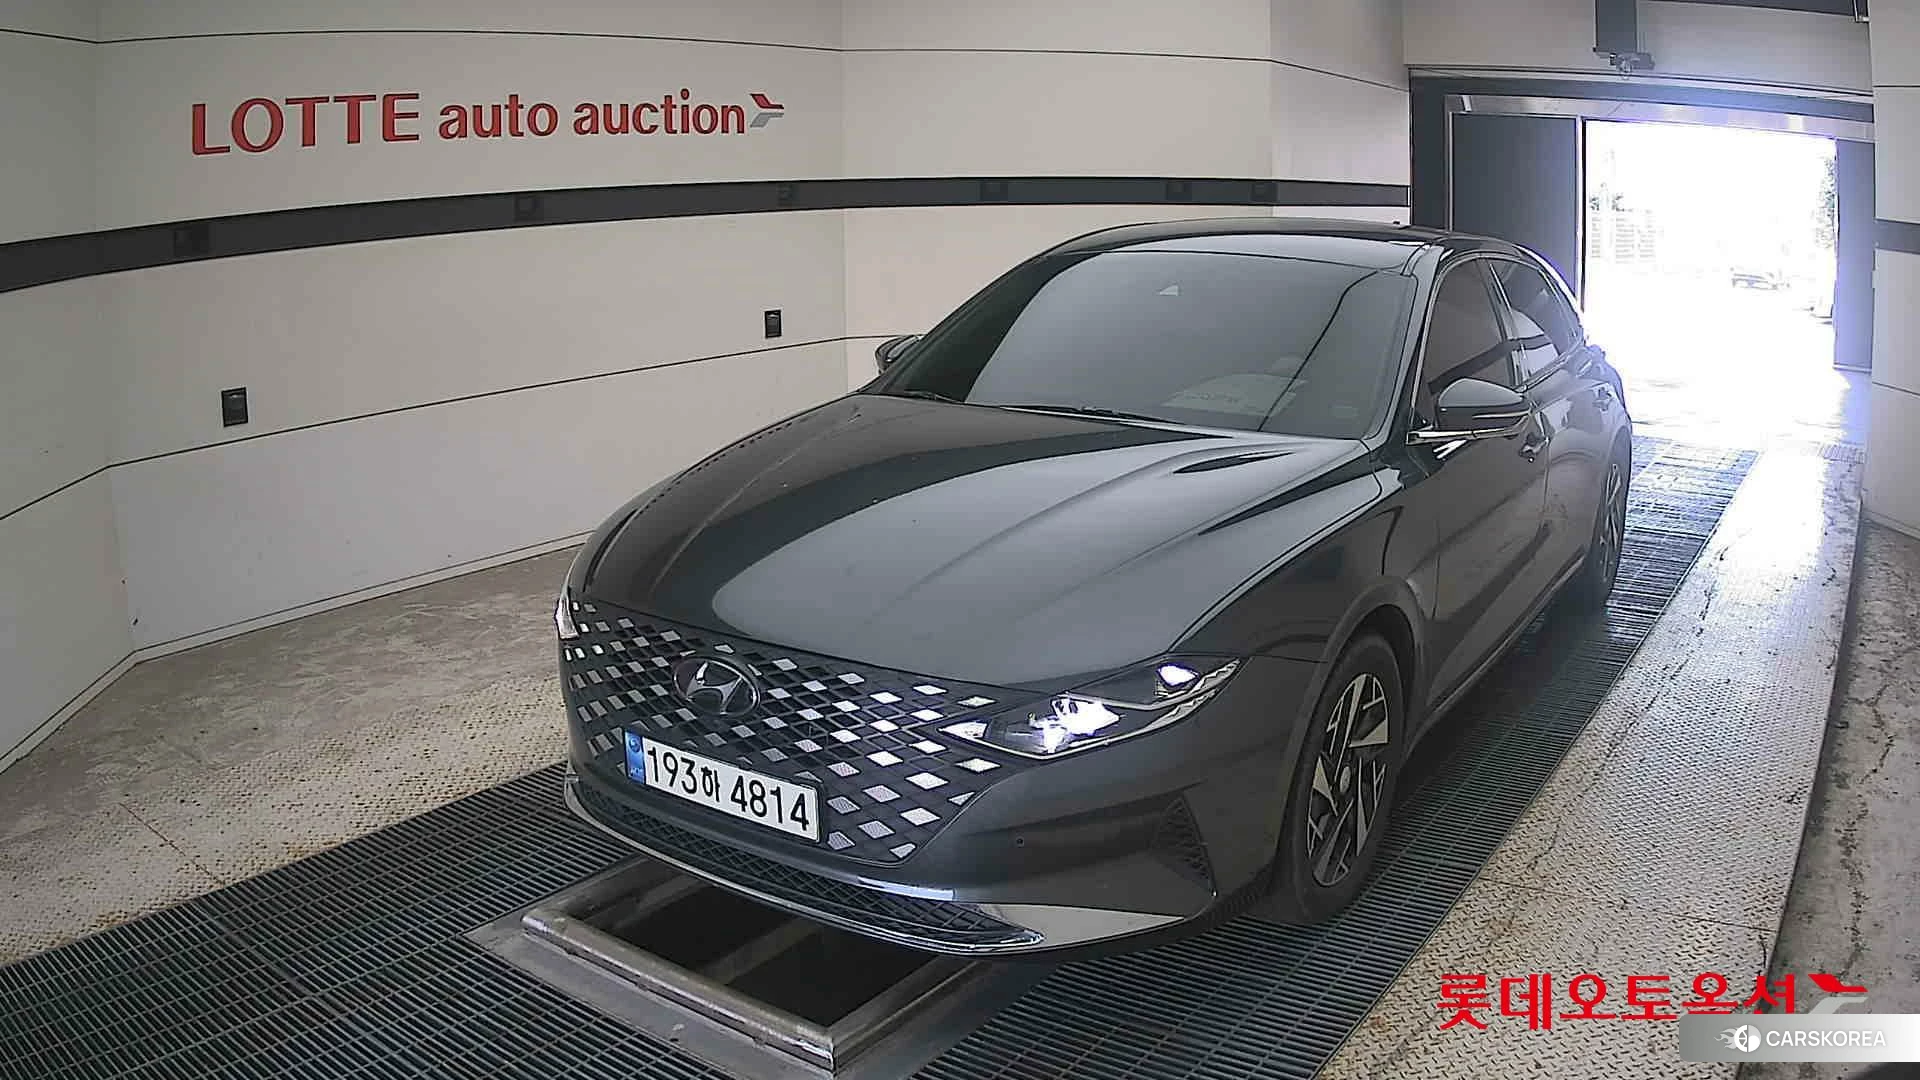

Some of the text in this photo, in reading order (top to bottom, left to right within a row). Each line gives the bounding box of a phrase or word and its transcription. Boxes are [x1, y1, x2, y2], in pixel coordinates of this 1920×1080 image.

[192, 88, 745, 156] LOTTE auto auction
[647, 746, 810, 831] 193하 4814
